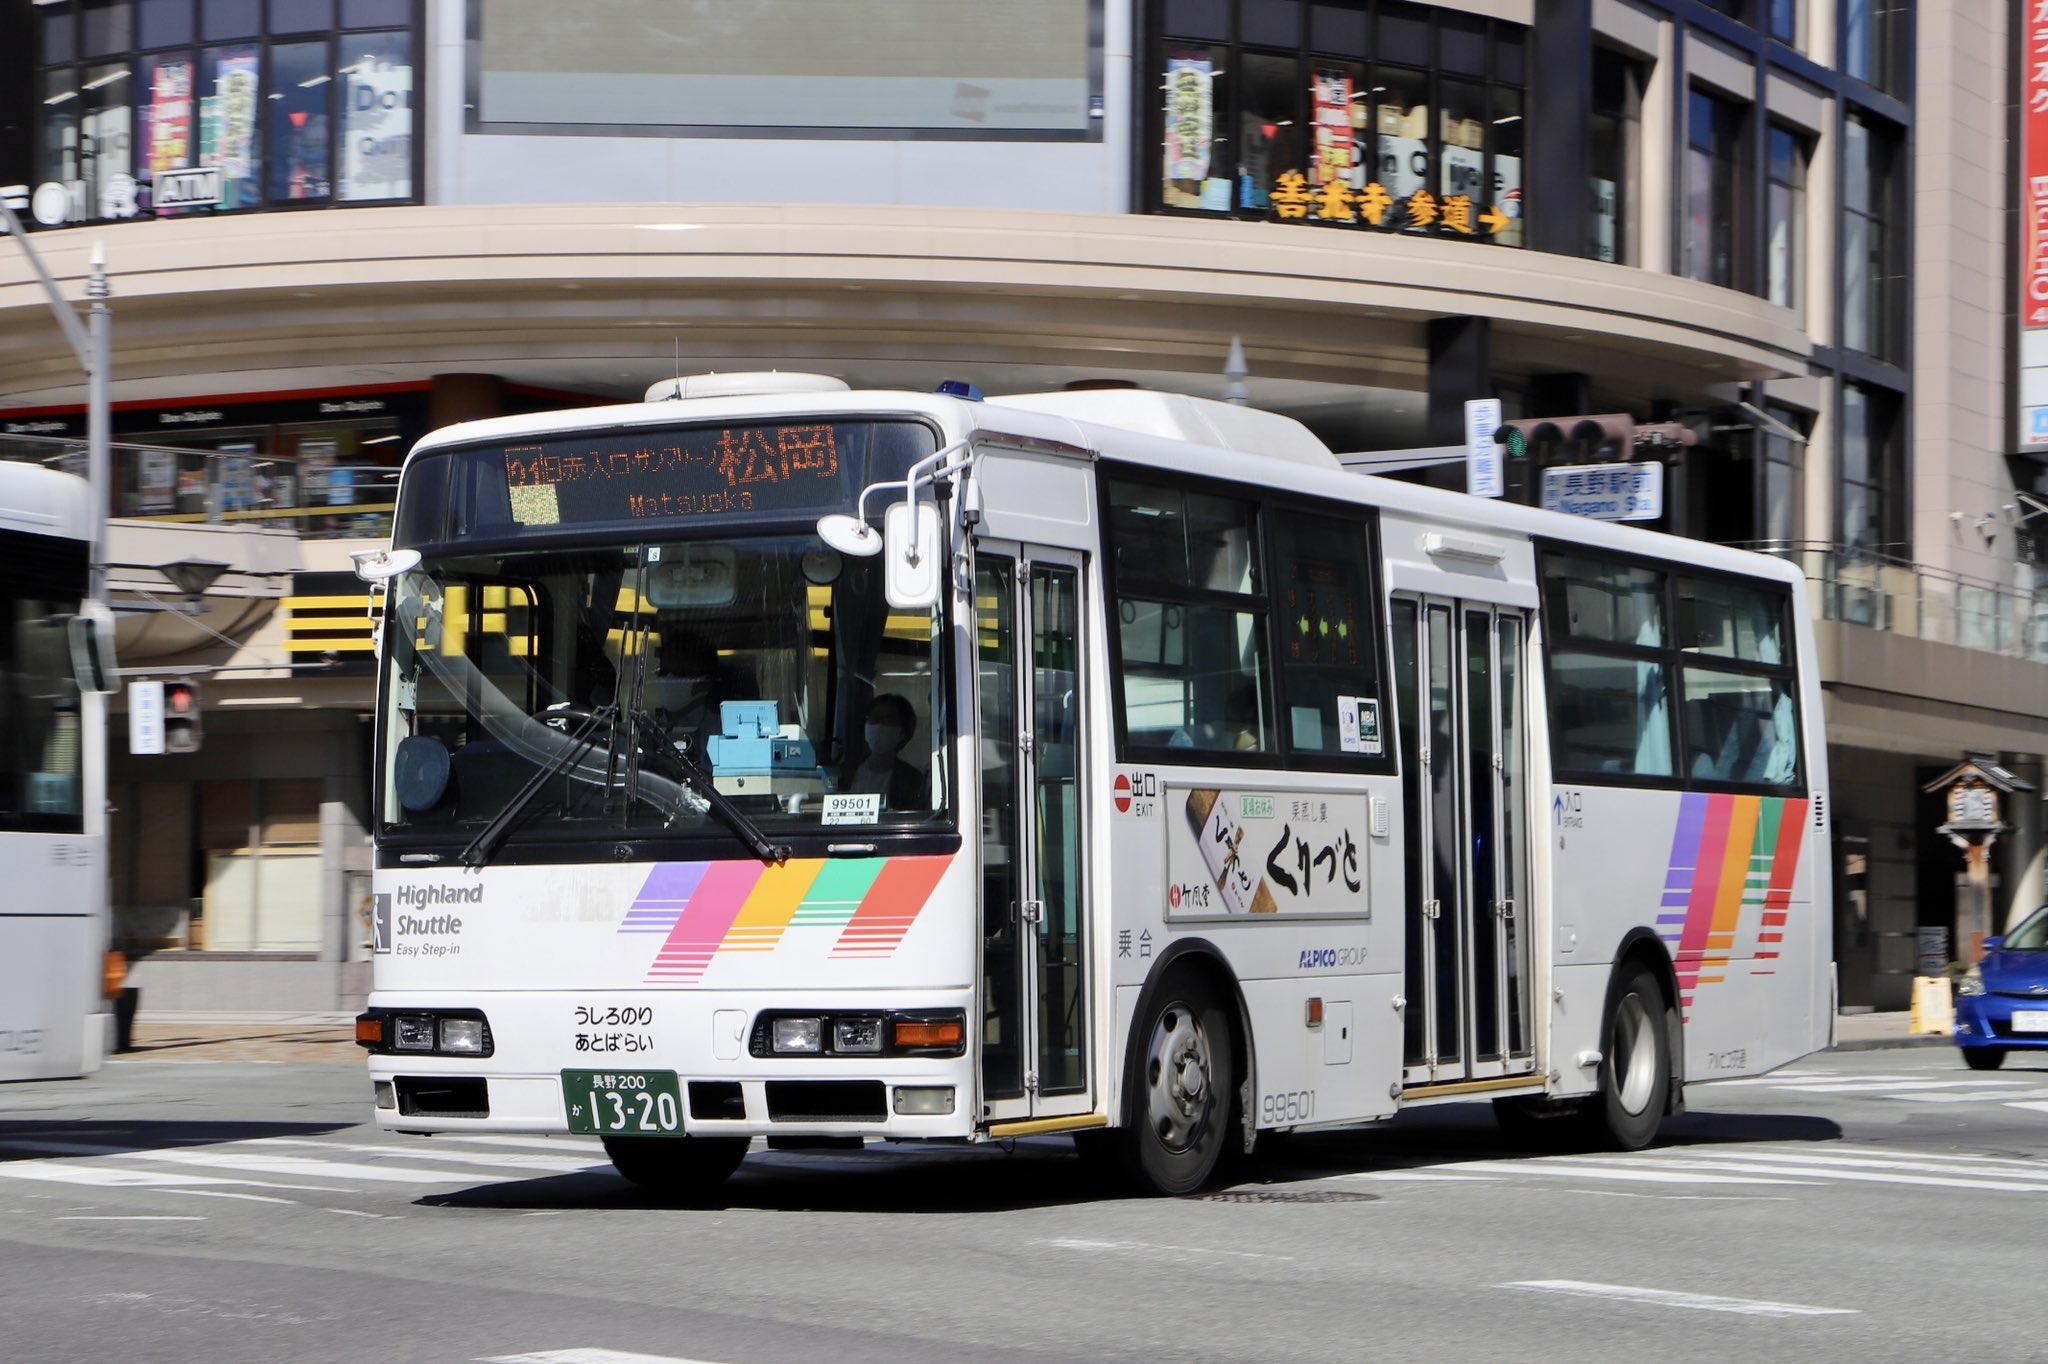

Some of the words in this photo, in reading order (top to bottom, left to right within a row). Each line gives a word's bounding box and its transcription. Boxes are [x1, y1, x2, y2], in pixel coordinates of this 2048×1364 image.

[158, 174, 217, 201] ATM
[1406, 189, 1474, 234] 参道
[716, 425, 836, 486] 松岡
[1562, 469, 1653, 496] 長野駅前
[629, 489, 753, 517] Matsuoka
[1560, 500, 1618, 516] Nagano
[1132, 772, 1156, 797] 出口
[832, 798, 871, 810] 99501
[1136, 803, 1153, 817] EXIT
[397, 883, 484, 910] Highland
[1182, 882, 1210, 908] 竹風堂
[397, 914, 462, 935] Shuttle
[396, 943, 420, 958] Easy
[421, 942, 461, 957] Step-in
[1299, 949, 1336, 968] ALPICO
[1337, 947, 1368, 967] GROUP
[574, 1006, 653, 1026] うしろのり
[575, 1033, 654, 1053] あとばらい
[571, 1103, 583, 1117] か
[589, 1090, 678, 1131] 13-20
[1262, 1089, 1316, 1125] 99501
